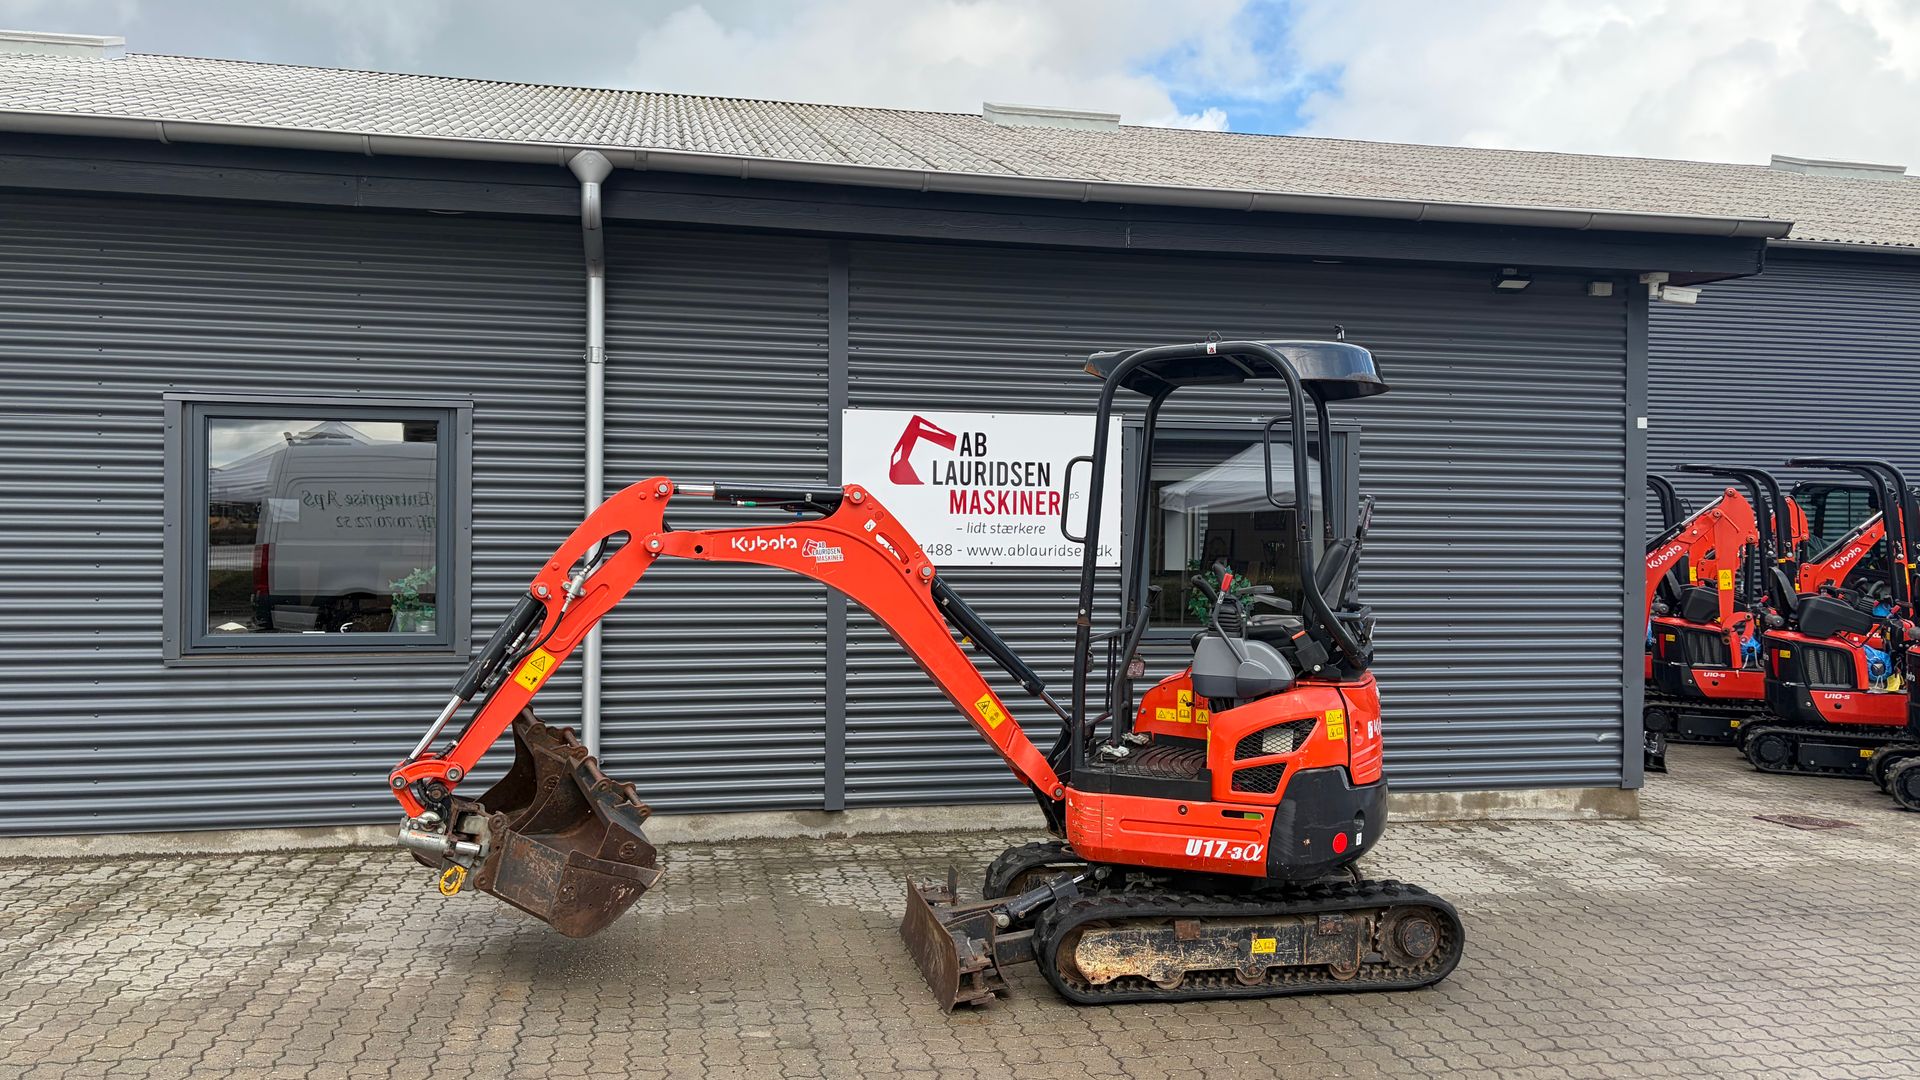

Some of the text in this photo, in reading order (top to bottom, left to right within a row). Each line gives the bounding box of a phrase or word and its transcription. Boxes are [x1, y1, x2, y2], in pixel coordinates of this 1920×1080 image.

[960, 432, 987, 457] AB
[932, 460, 1050, 487] LAURIDSEN
[949, 489, 1080, 516] MASKINER pS
[966, 522, 987, 534] lidt
[990, 523, 1046, 535] stærkere
[731, 534, 798, 552] Kubota
[966, 543, 1112, 557] www.ablauridsedk
[1647, 545, 1682, 569] Kubota
[1830, 547, 1862, 569] Kubota
